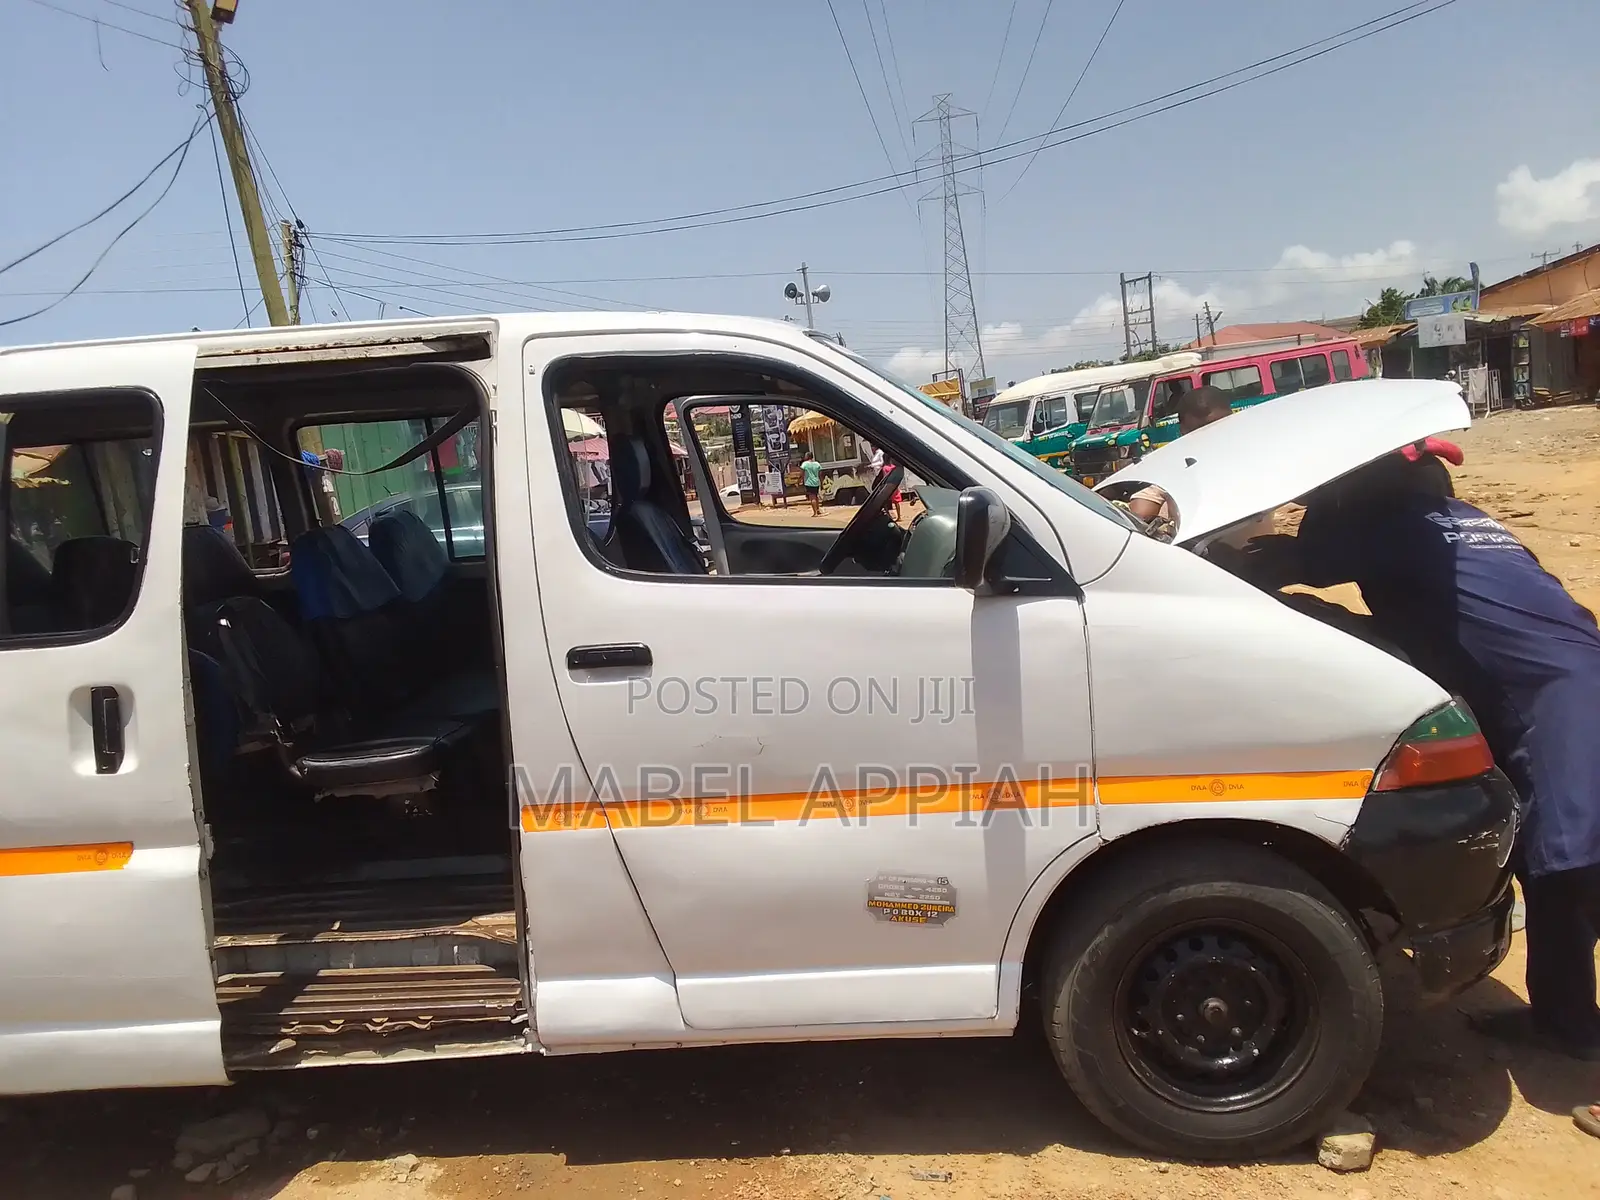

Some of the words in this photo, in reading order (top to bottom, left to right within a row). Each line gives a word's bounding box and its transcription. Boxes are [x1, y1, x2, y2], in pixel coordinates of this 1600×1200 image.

[937, 877, 949, 885] 15
[867, 900, 919, 910] MOHAMMED
[901, 909, 923, 917] BOX
[890, 915, 928, 924] AKUSE
